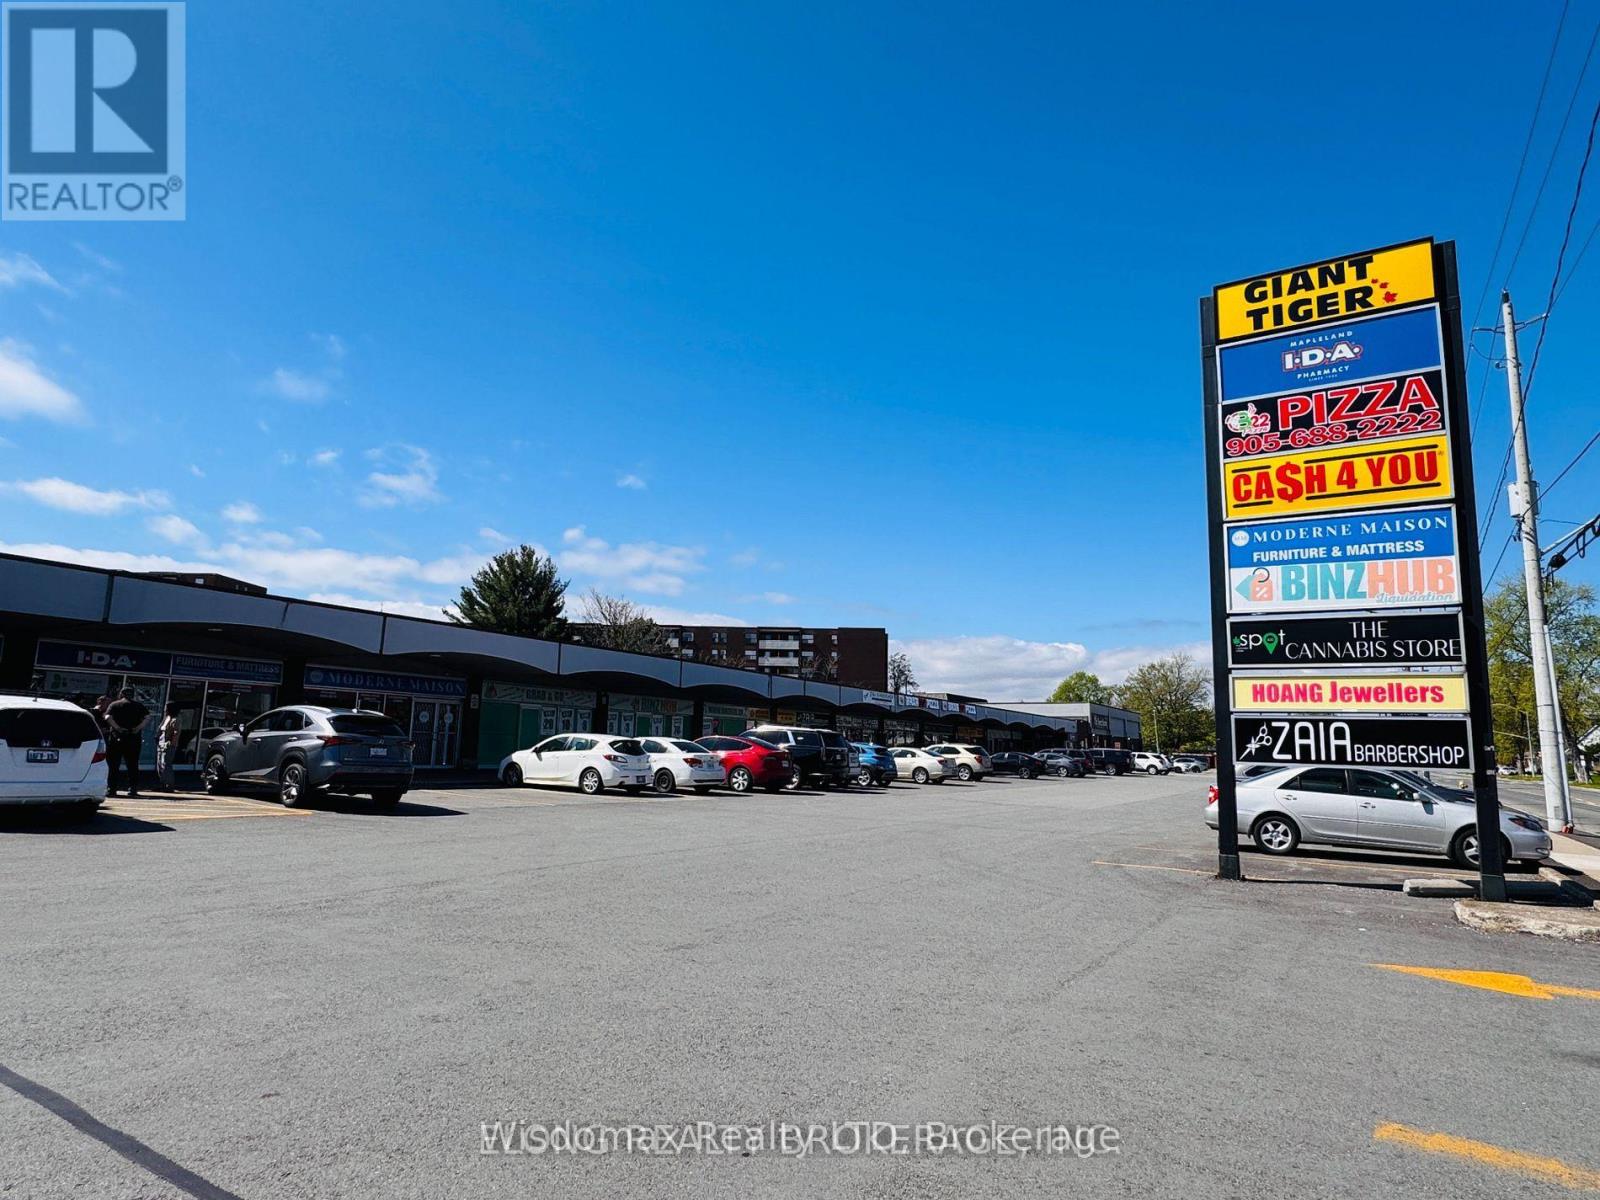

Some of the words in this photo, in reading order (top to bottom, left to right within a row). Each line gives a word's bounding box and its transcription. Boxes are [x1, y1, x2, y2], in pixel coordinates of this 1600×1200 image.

[1244, 255, 1374, 304] GIANT
[1246, 285, 1375, 331] TIGER
[1290, 330, 1353, 347] MAPLELAND
[1297, 365, 1350, 379] PHARMACY
[1278, 376, 1439, 431] PIZZA
[1226, 410, 1441, 456] 905-688-2222
[1233, 462, 1327, 503] CA$H
[1337, 467, 1358, 489] 4
[1366, 451, 1439, 487] YOU
[1253, 524, 1352, 543] MODERNE
[1360, 516, 1449, 534] MAISON
[1253, 546, 1327, 563] FURNITURE
[1331, 545, 1343, 557] &
[1346, 540, 1425, 556] MATTRESS
[1281, 557, 1456, 601] BINZHUB
[1349, 620, 1389, 639] THE
[1285, 641, 1388, 660] CANNABIS
[1393, 638, 1462, 657] STORE
[176, 656, 225, 669] FURNITURE
[326, 671, 402, 688] MODERNE
[409, 679, 465, 695] MAISON
[1251, 683, 1323, 703] HOANG
[1329, 681, 1445, 703] Jewellers
[1270, 721, 1351, 761] ZAIA
[1354, 743, 1465, 765] BARBERSHOP
